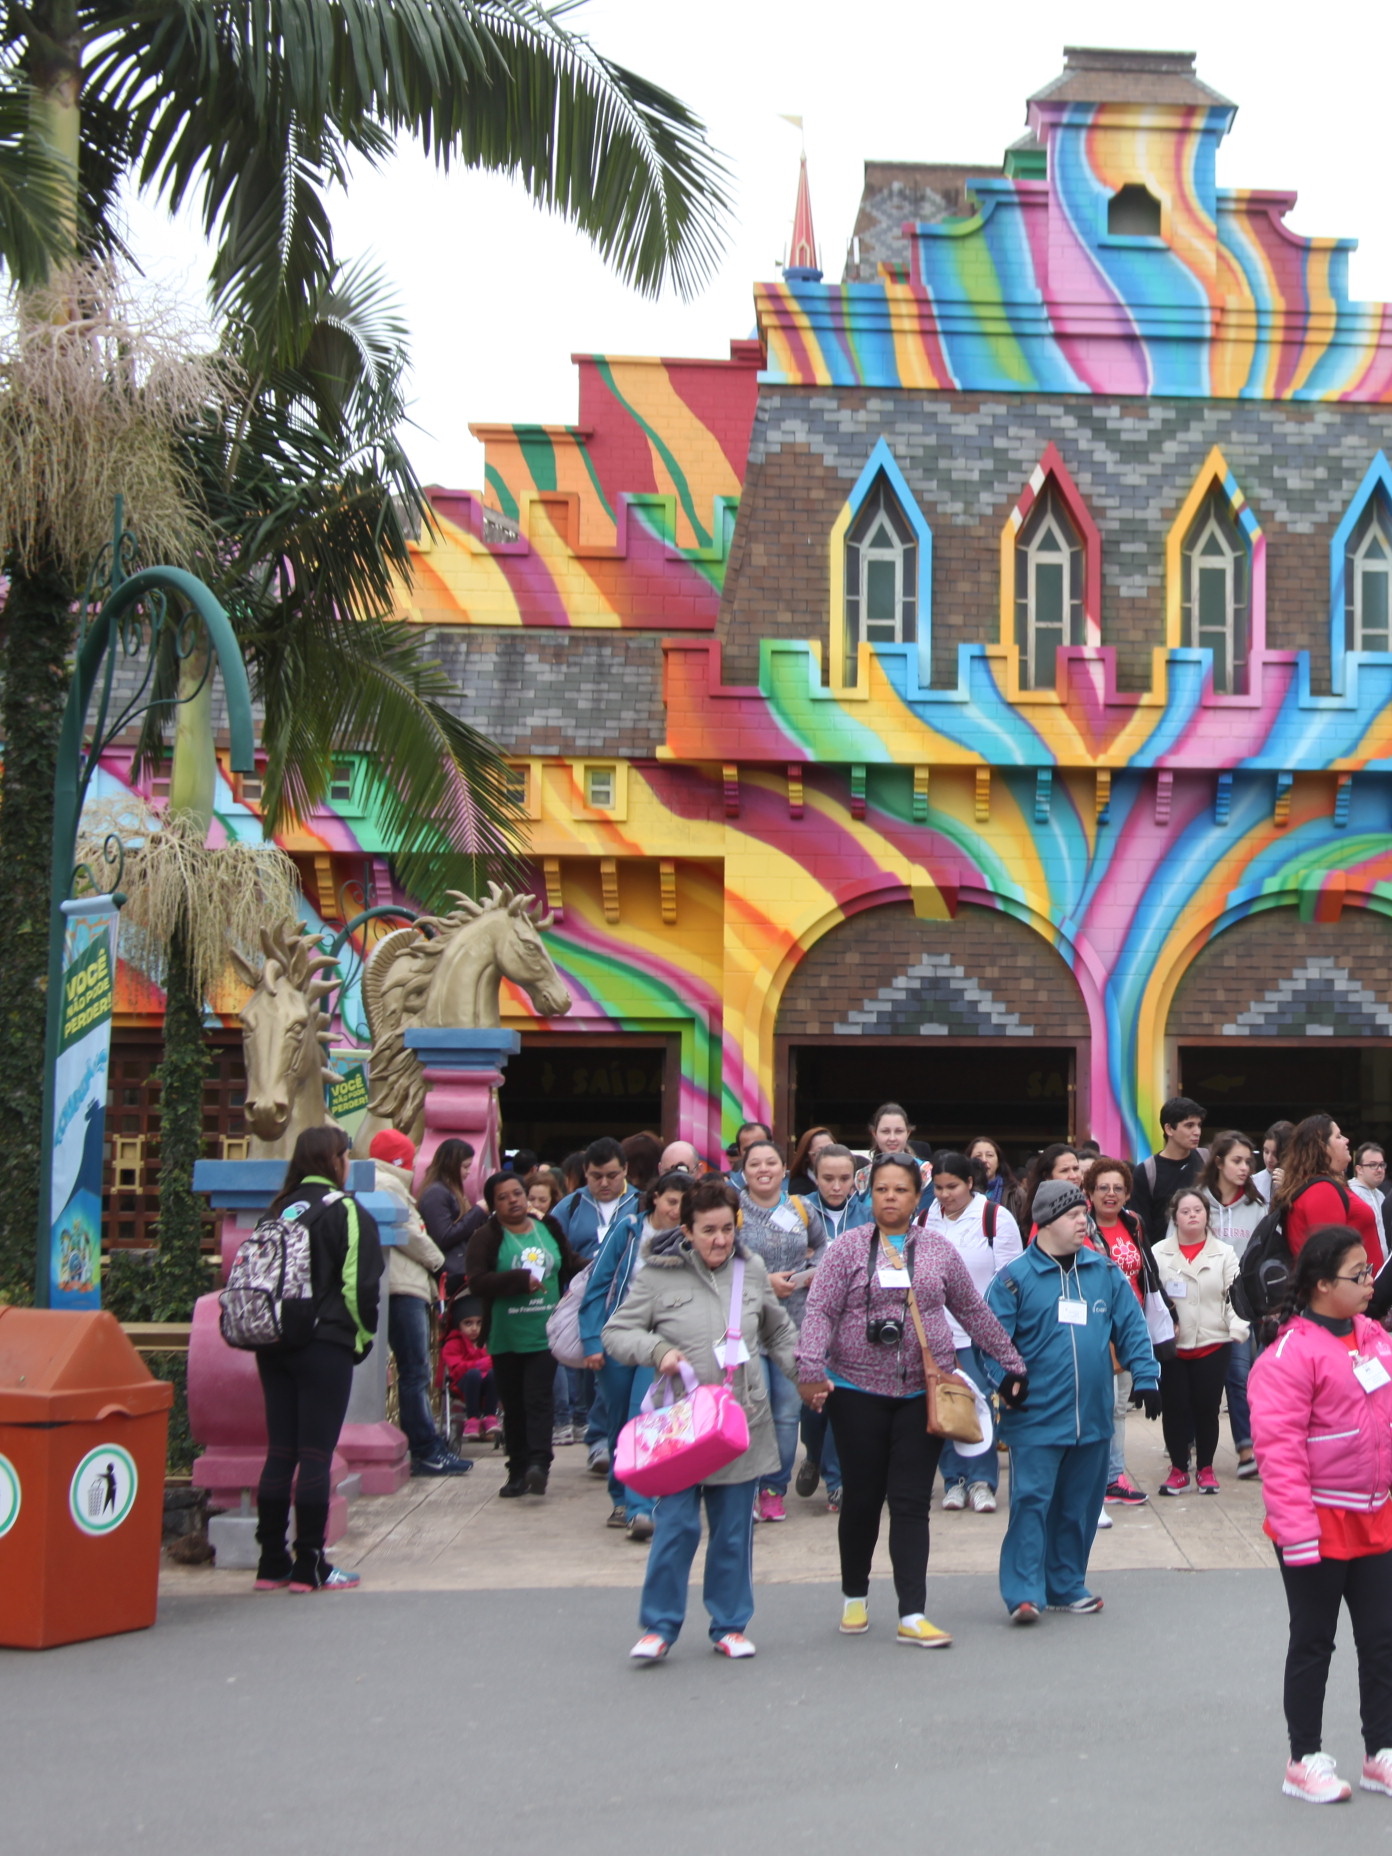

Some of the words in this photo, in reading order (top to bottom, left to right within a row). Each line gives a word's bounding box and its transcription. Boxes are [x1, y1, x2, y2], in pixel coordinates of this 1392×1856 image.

[66, 948, 108, 1001] VOCÊ
[64, 991, 112, 1039] PERDER!
[66, 996, 86, 1019] NÃO
[86, 977, 110, 1005] PODE
[331, 1073, 364, 1097] VOCÊ
[331, 1095, 368, 1114] PERDER!
